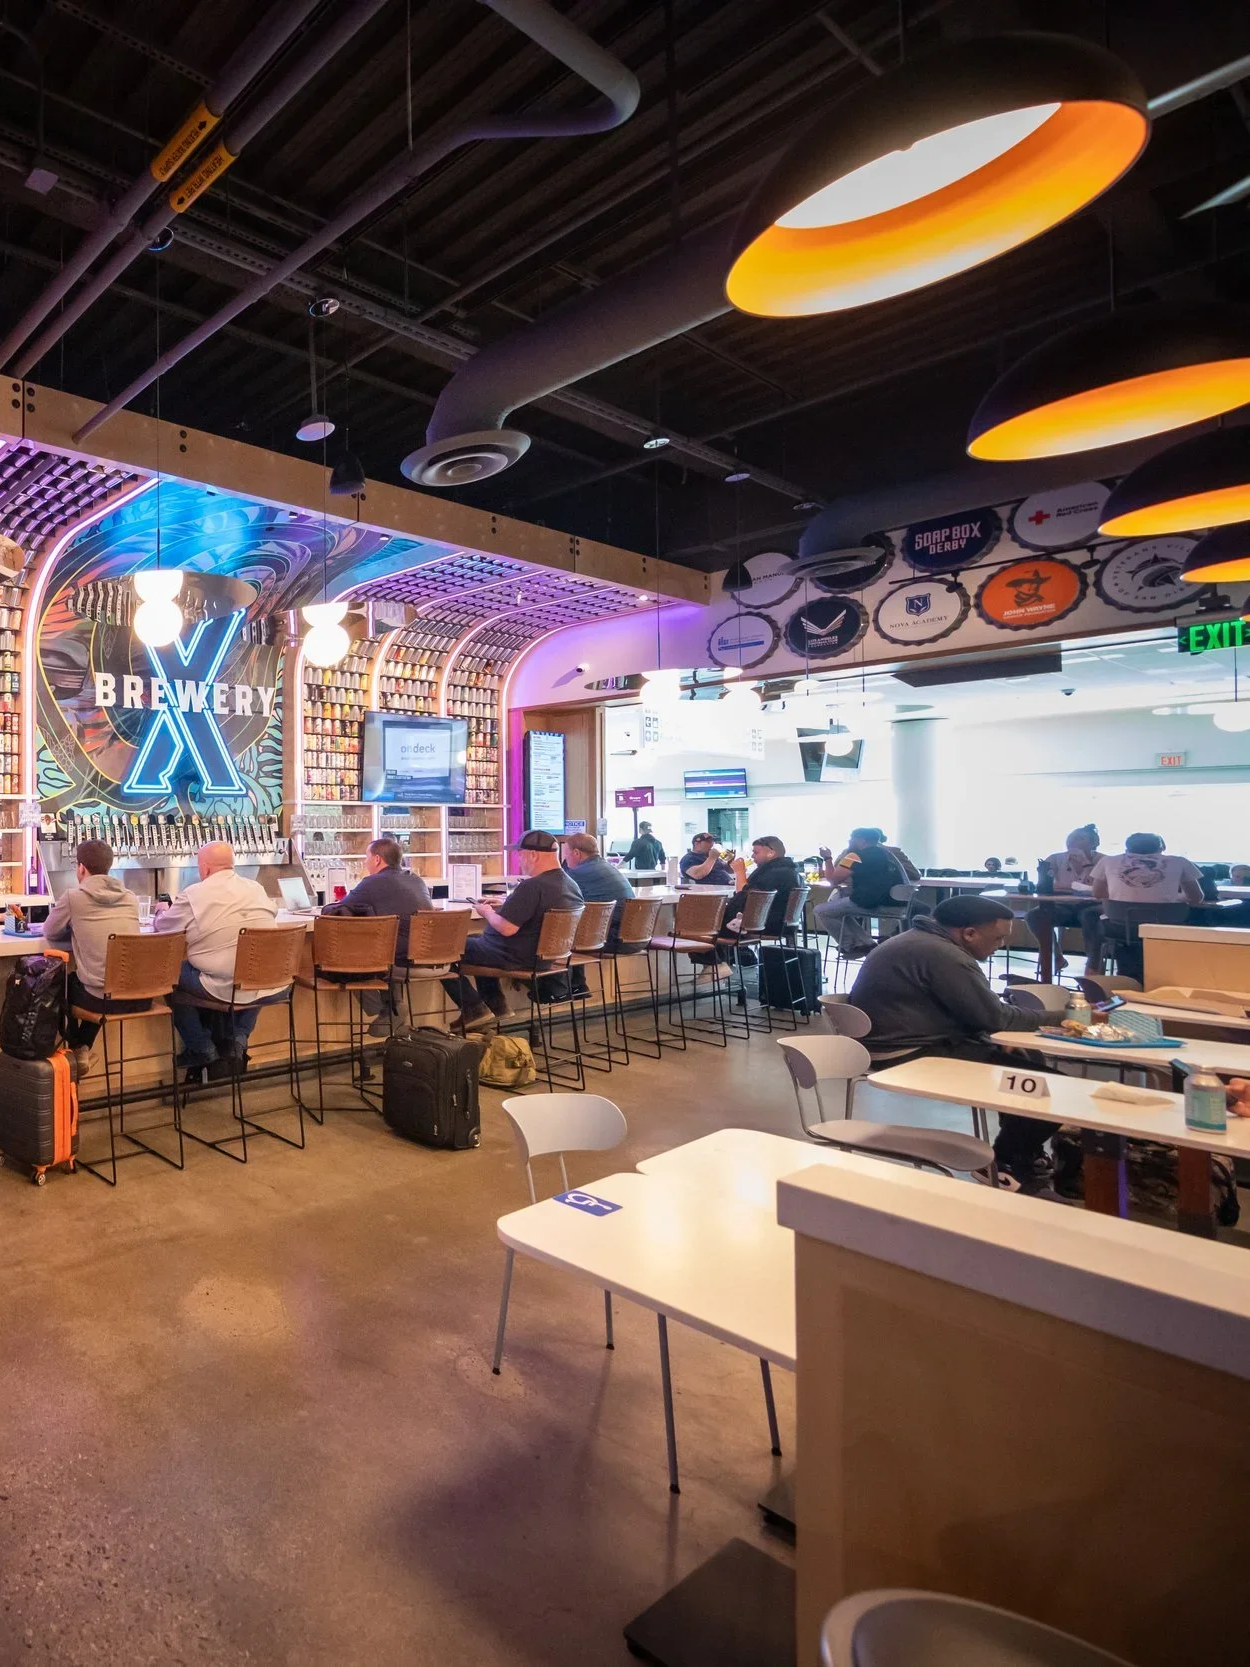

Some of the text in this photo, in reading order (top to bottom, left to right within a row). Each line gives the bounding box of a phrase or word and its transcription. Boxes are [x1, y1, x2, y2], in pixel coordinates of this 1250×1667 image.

[201, 154, 225, 179] HEATING
[1056, 501, 1099, 512] American
[915, 521, 982, 551] SOAP BOX
[929, 538, 967, 555] DERBY
[913, 598, 923, 609] N
[1003, 603, 1055, 617] JOHN WAYNE
[889, 615, 949, 630] NOVA ACADEMY
[1189, 620, 1246, 653] EXIT
[95, 671, 276, 718] BREWERY
[124, 608, 247, 796] X
[1161, 755, 1182, 766] EXIT
[643, 791, 652, 804] 1
[1007, 1075, 1037, 1094] 10
